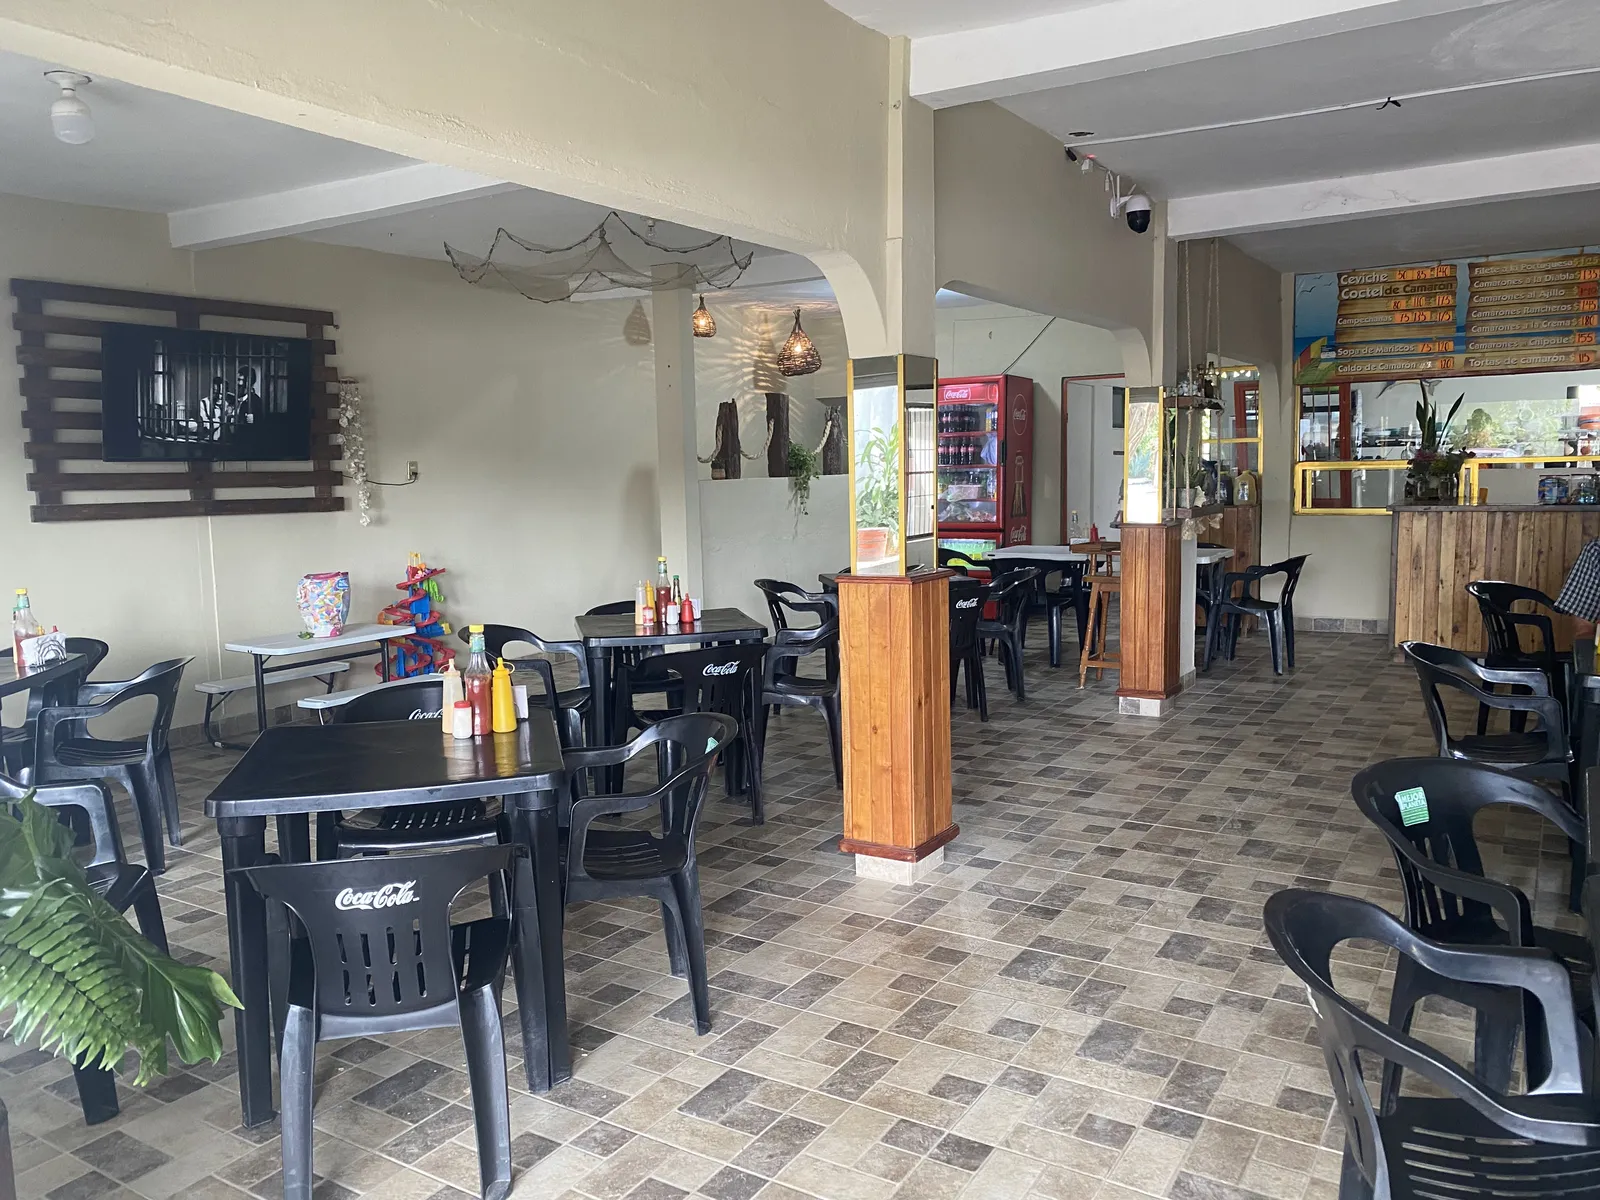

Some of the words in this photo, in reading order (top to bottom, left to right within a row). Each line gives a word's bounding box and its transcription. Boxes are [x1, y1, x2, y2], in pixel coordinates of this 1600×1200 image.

[1520, 260, 1574, 272] Portuguesa
[1340, 272, 1389, 286] Ceviche
[1473, 278, 1524, 289] Camarones
[1533, 274, 1542, 283] la
[1544, 270, 1576, 282] Diabla
[1341, 286, 1383, 300] Coctel
[1384, 285, 1400, 295] de
[1473, 291, 1525, 304] Camarones
[1527, 290, 1536, 299] al
[1539, 287, 1566, 299] Ajillo
[1471, 308, 1521, 319] Camarones
[1523, 303, 1572, 315] Rancheros
[1471, 322, 1521, 333] Camarones
[1530, 320, 1539, 329] la
[1541, 318, 1571, 328] Crema
[1338, 347, 1361, 357] Sopa
[1361, 345, 1375, 354] de
[1375, 343, 1416, 354] Mariscos
[1469, 339, 1519, 350] Camarones
[1338, 363, 1363, 373] Caldo
[1365, 362, 1377, 371] de
[1378, 360, 1417, 371] Camarón
[1468, 356, 1501, 368] Tortas
[1505, 354, 1518, 365] de
[702, 660, 741, 676] Coca-Cola
[334, 879, 420, 911] Coca-Cola
